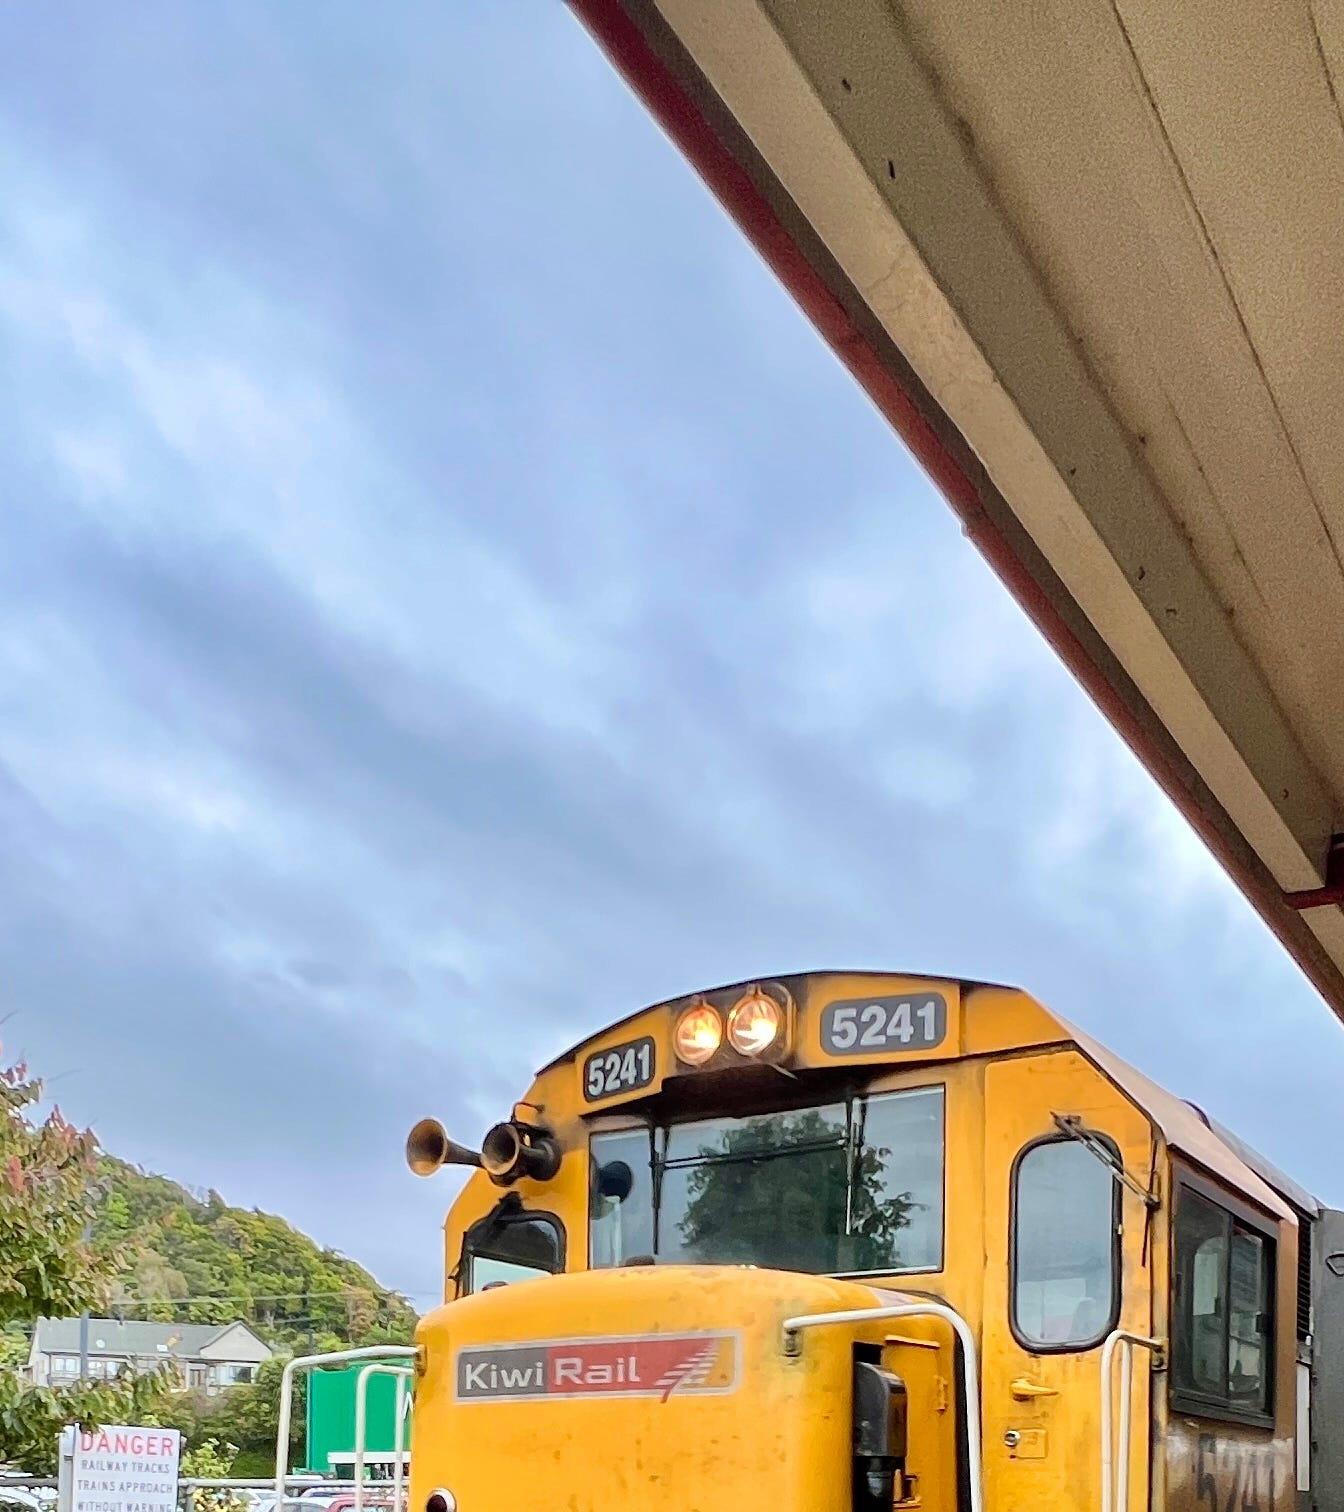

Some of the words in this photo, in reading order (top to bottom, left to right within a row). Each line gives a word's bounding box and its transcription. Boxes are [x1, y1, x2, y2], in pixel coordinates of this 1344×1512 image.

[830, 1000, 937, 1049] 5241
[587, 1043, 651, 1097] 5241
[80, 1431, 174, 1457] DANGER
[81, 1459, 129, 1473] RAILWAY
[131, 1461, 171, 1474] TRACKS
[77, 1479, 116, 1492] TRAINS
[118, 1481, 174, 1494] APPROACH
[77, 1501, 123, 1512] WITHOUT
